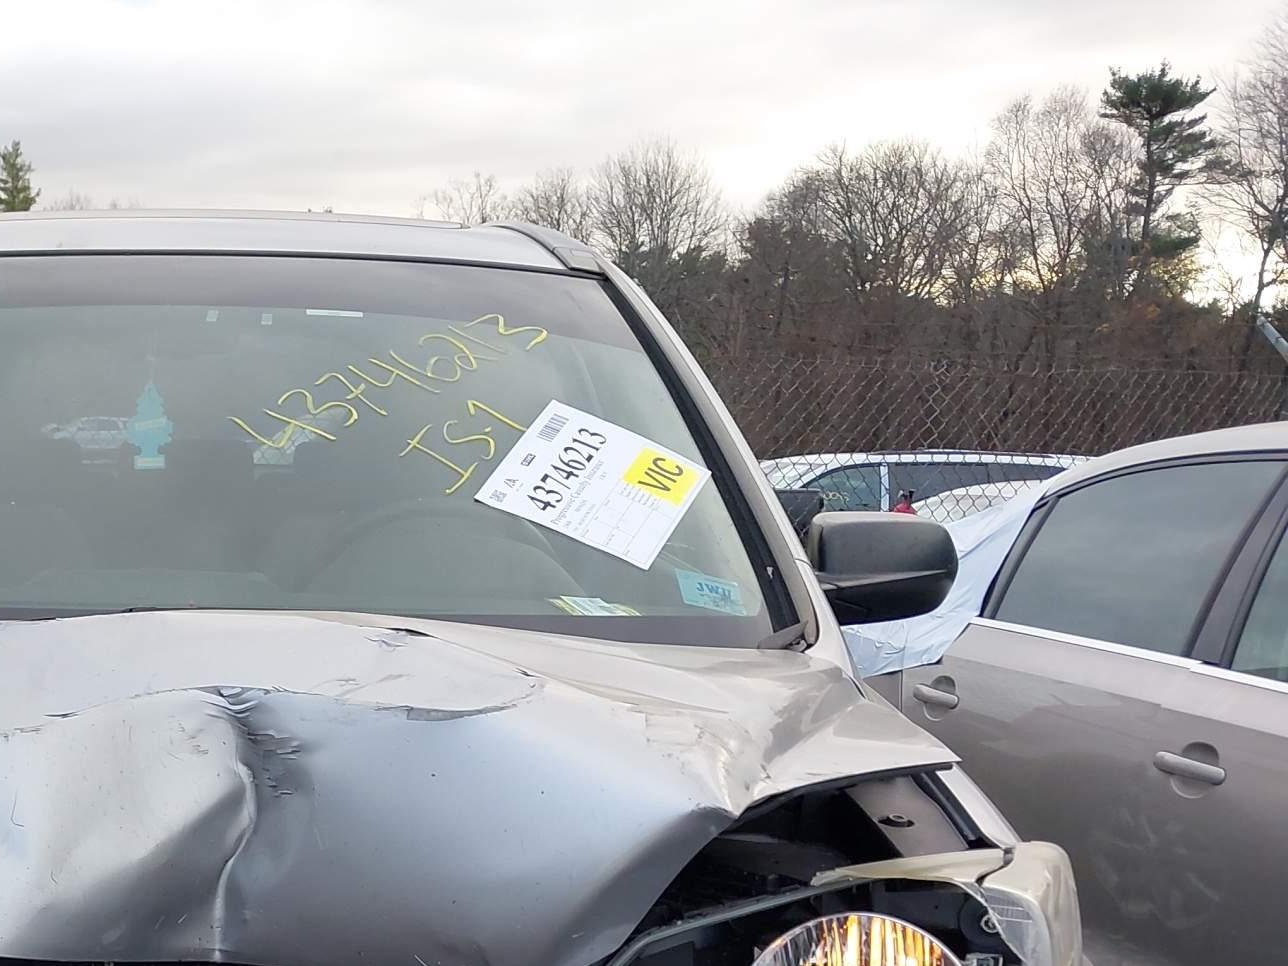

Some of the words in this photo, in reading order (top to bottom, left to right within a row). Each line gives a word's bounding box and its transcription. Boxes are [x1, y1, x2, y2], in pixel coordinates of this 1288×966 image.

[225, 314, 548, 448] 43746213
[526, 428, 607, 511] 43746213
[638, 457, 684, 492] VIC
